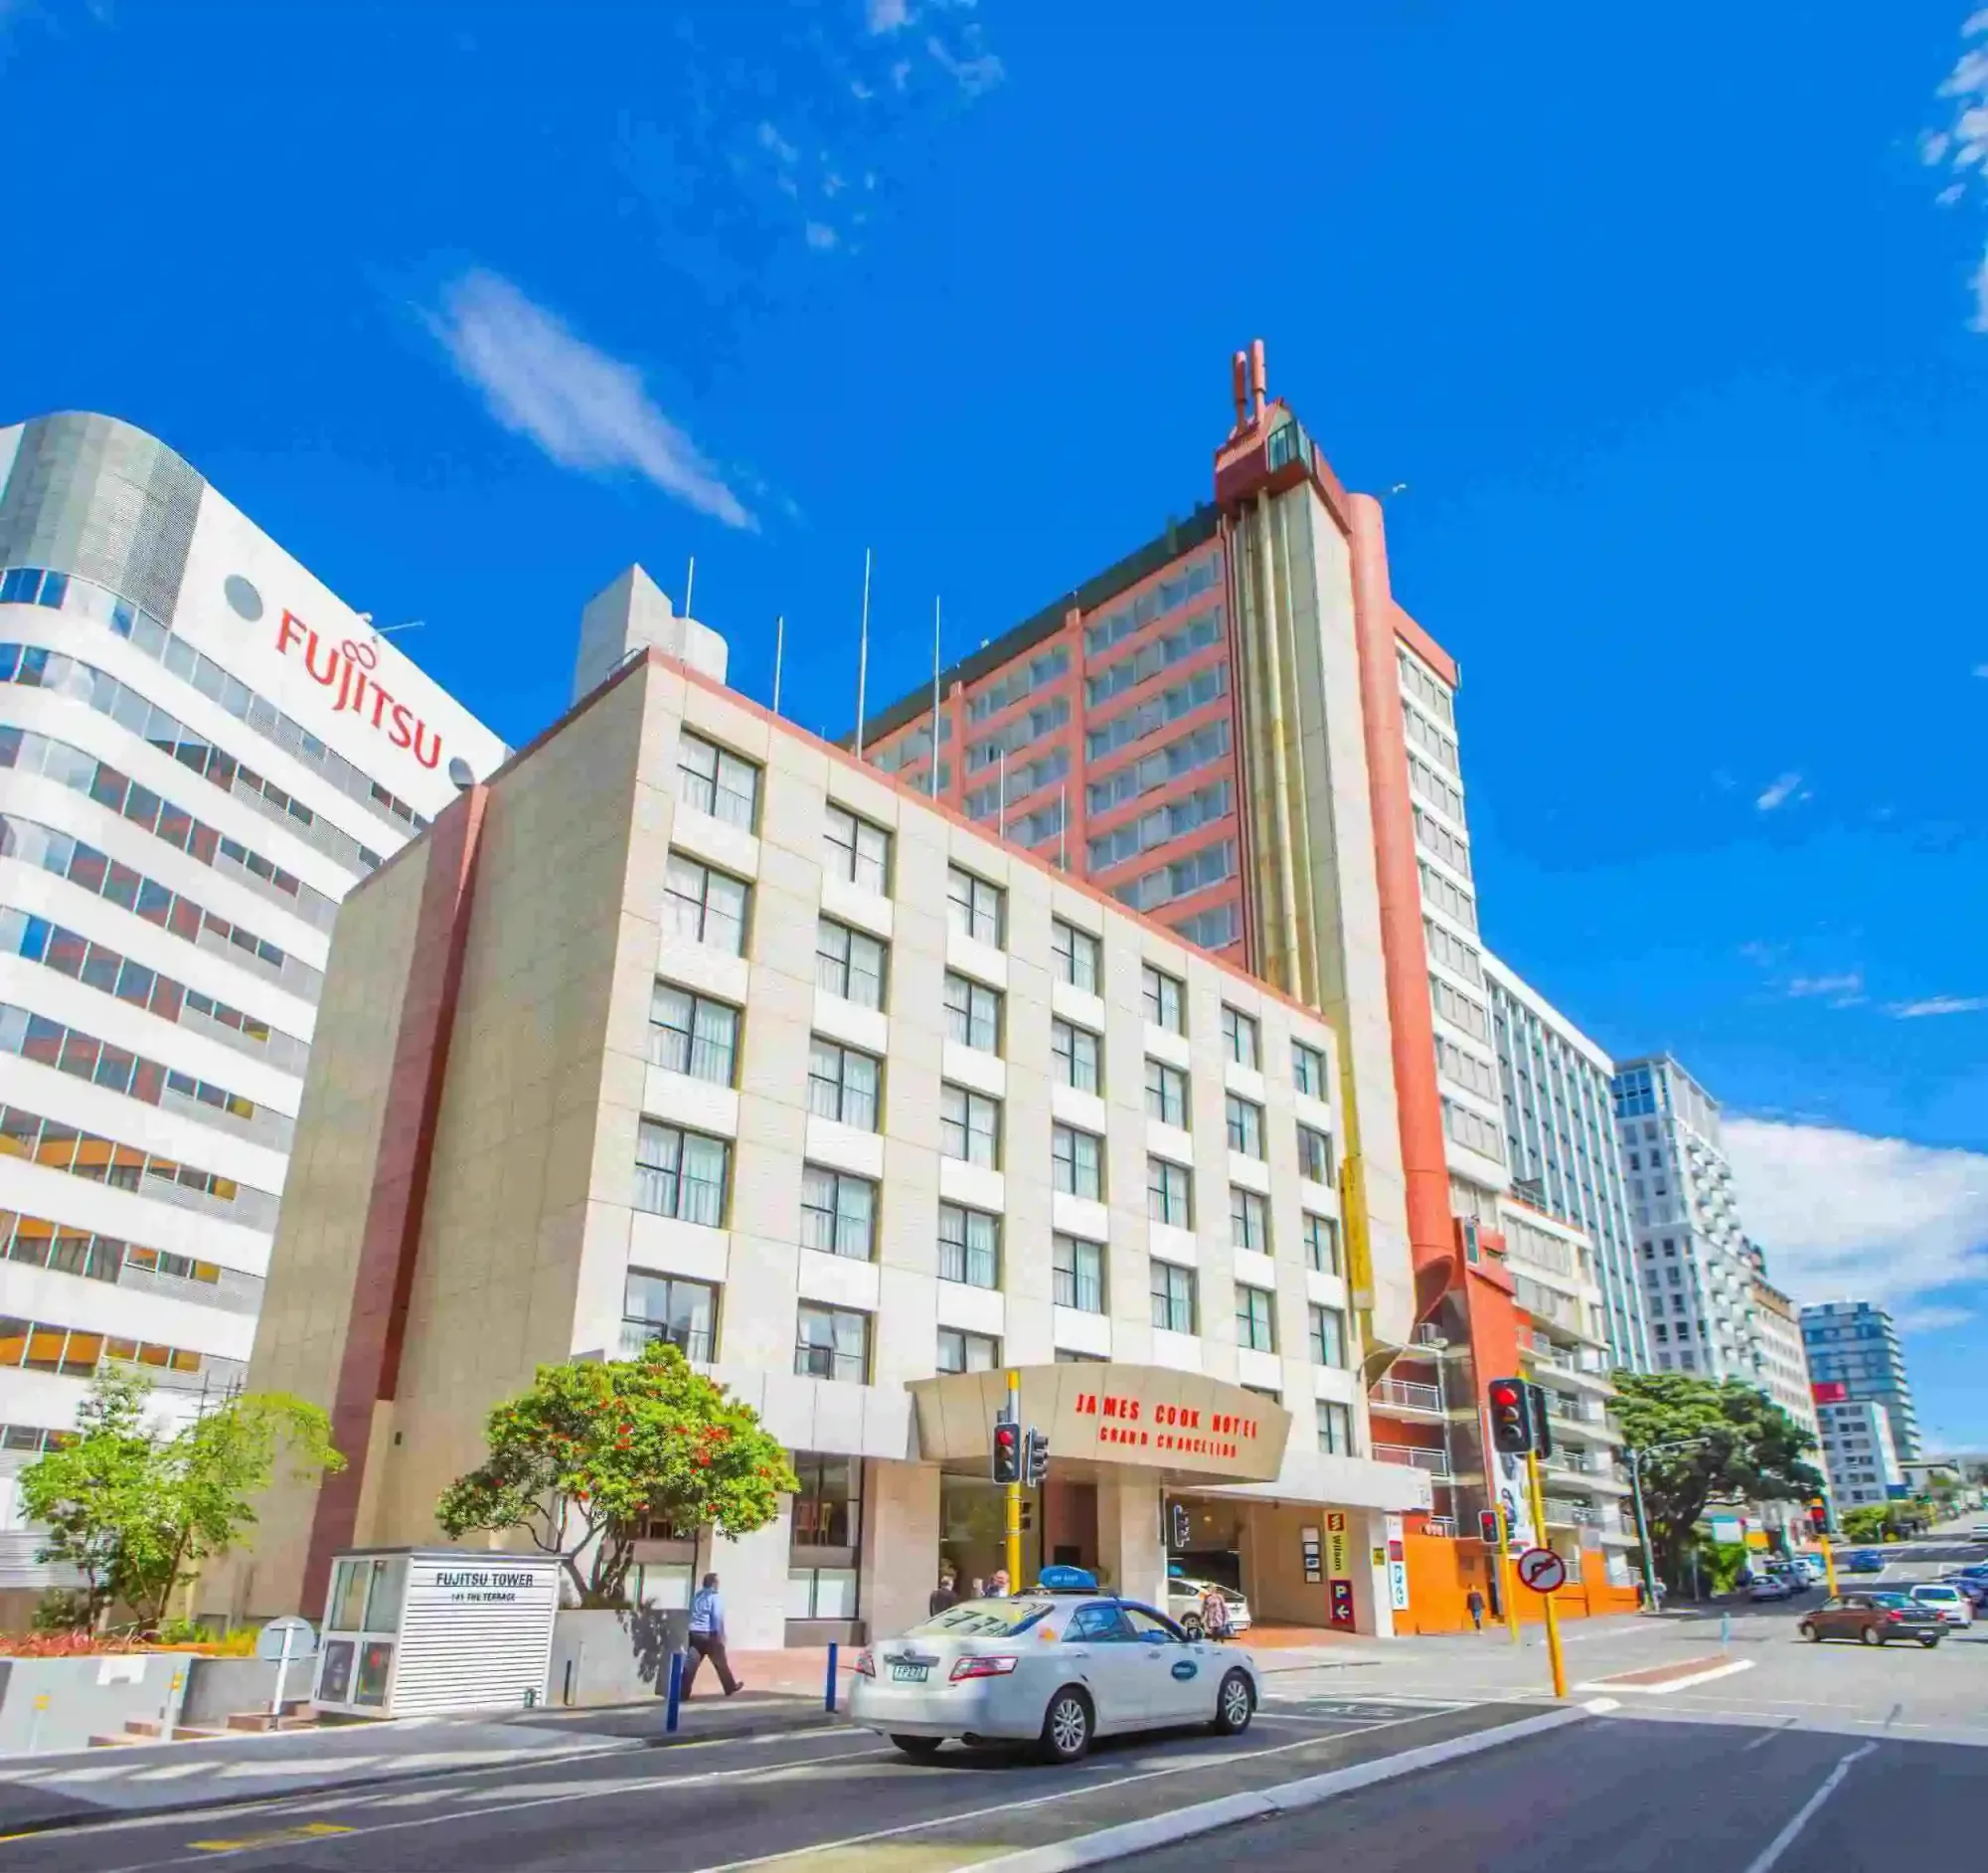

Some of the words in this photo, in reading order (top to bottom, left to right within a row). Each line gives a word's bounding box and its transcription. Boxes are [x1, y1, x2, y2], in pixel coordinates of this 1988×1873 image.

[275, 607, 442, 769] FUJITSU
[1076, 1393, 1140, 1421] JAMES
[1155, 1403, 1200, 1430] COOK
[1212, 1414, 1257, 1440] HOTEL
[1099, 1426, 1149, 1446] GRAND
[1332, 1534, 1343, 1571] Wilson
[436, 1572, 488, 1587] FUJITSU
[491, 1573, 534, 1588] TOWER
[467, 1592, 480, 1602] THE
[482, 1592, 516, 1602] TERRACE
[1335, 1585, 1347, 1599] P
